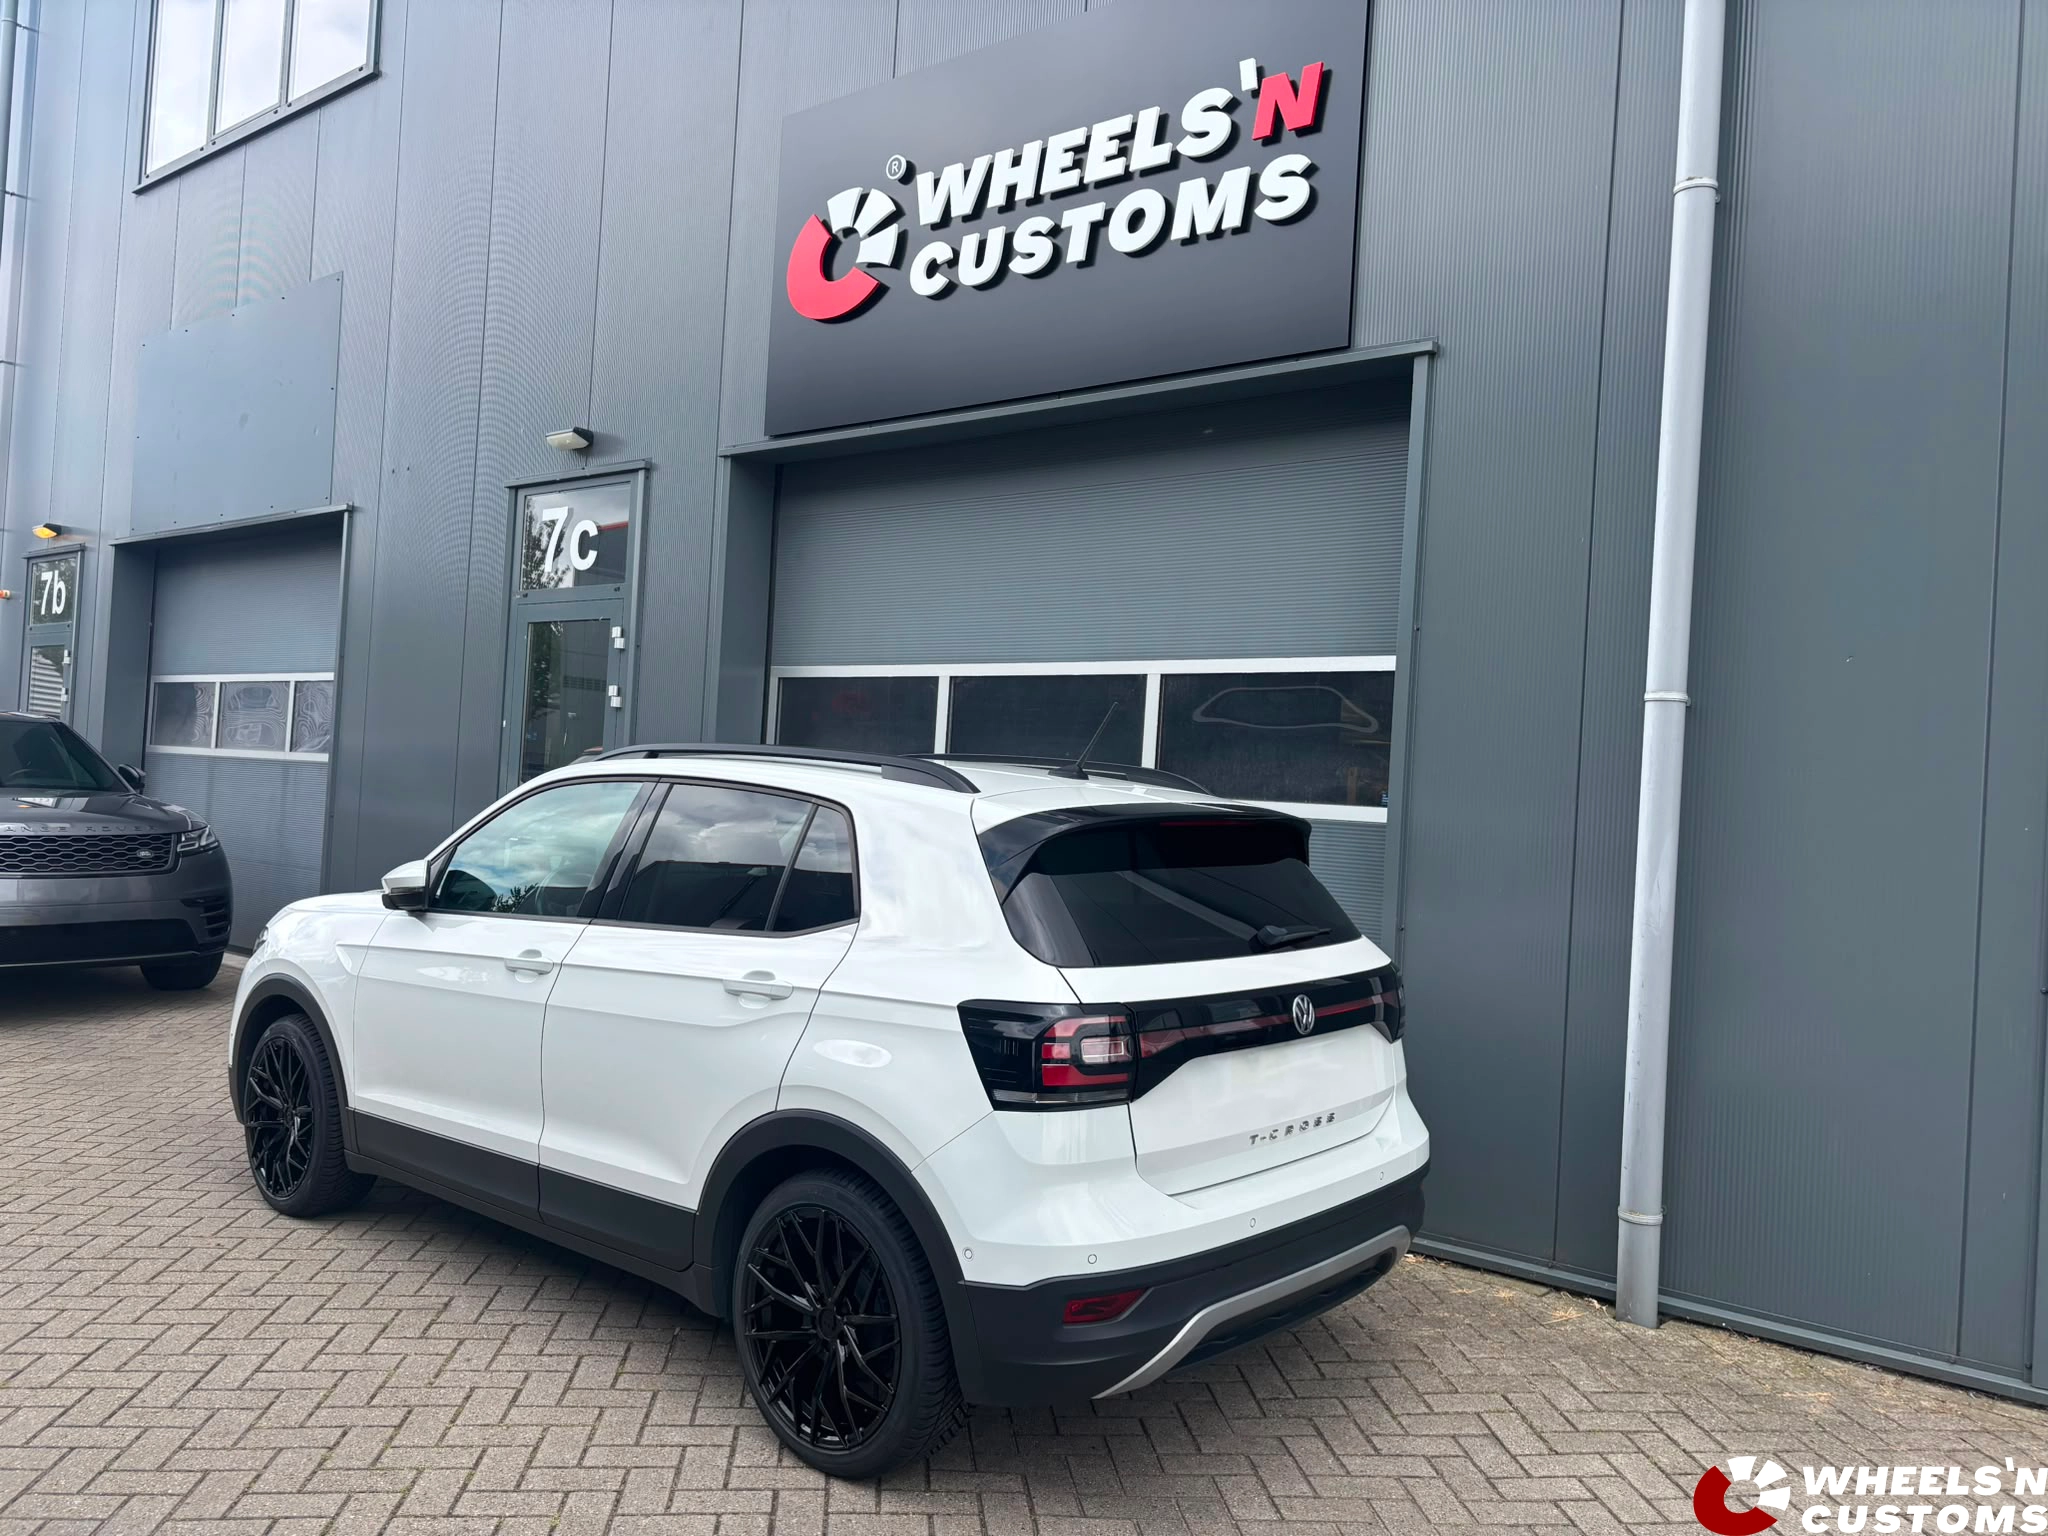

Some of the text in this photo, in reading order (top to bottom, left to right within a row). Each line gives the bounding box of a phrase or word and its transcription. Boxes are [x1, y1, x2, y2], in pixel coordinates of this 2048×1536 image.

[916, 57, 1325, 227] WHEELS'N
[909, 153, 1312, 297] CUSTOMS
[542, 506, 599, 572] 7c
[40, 569, 67, 616] 7b
[1249, 1112, 1336, 1146] T-CROSS
